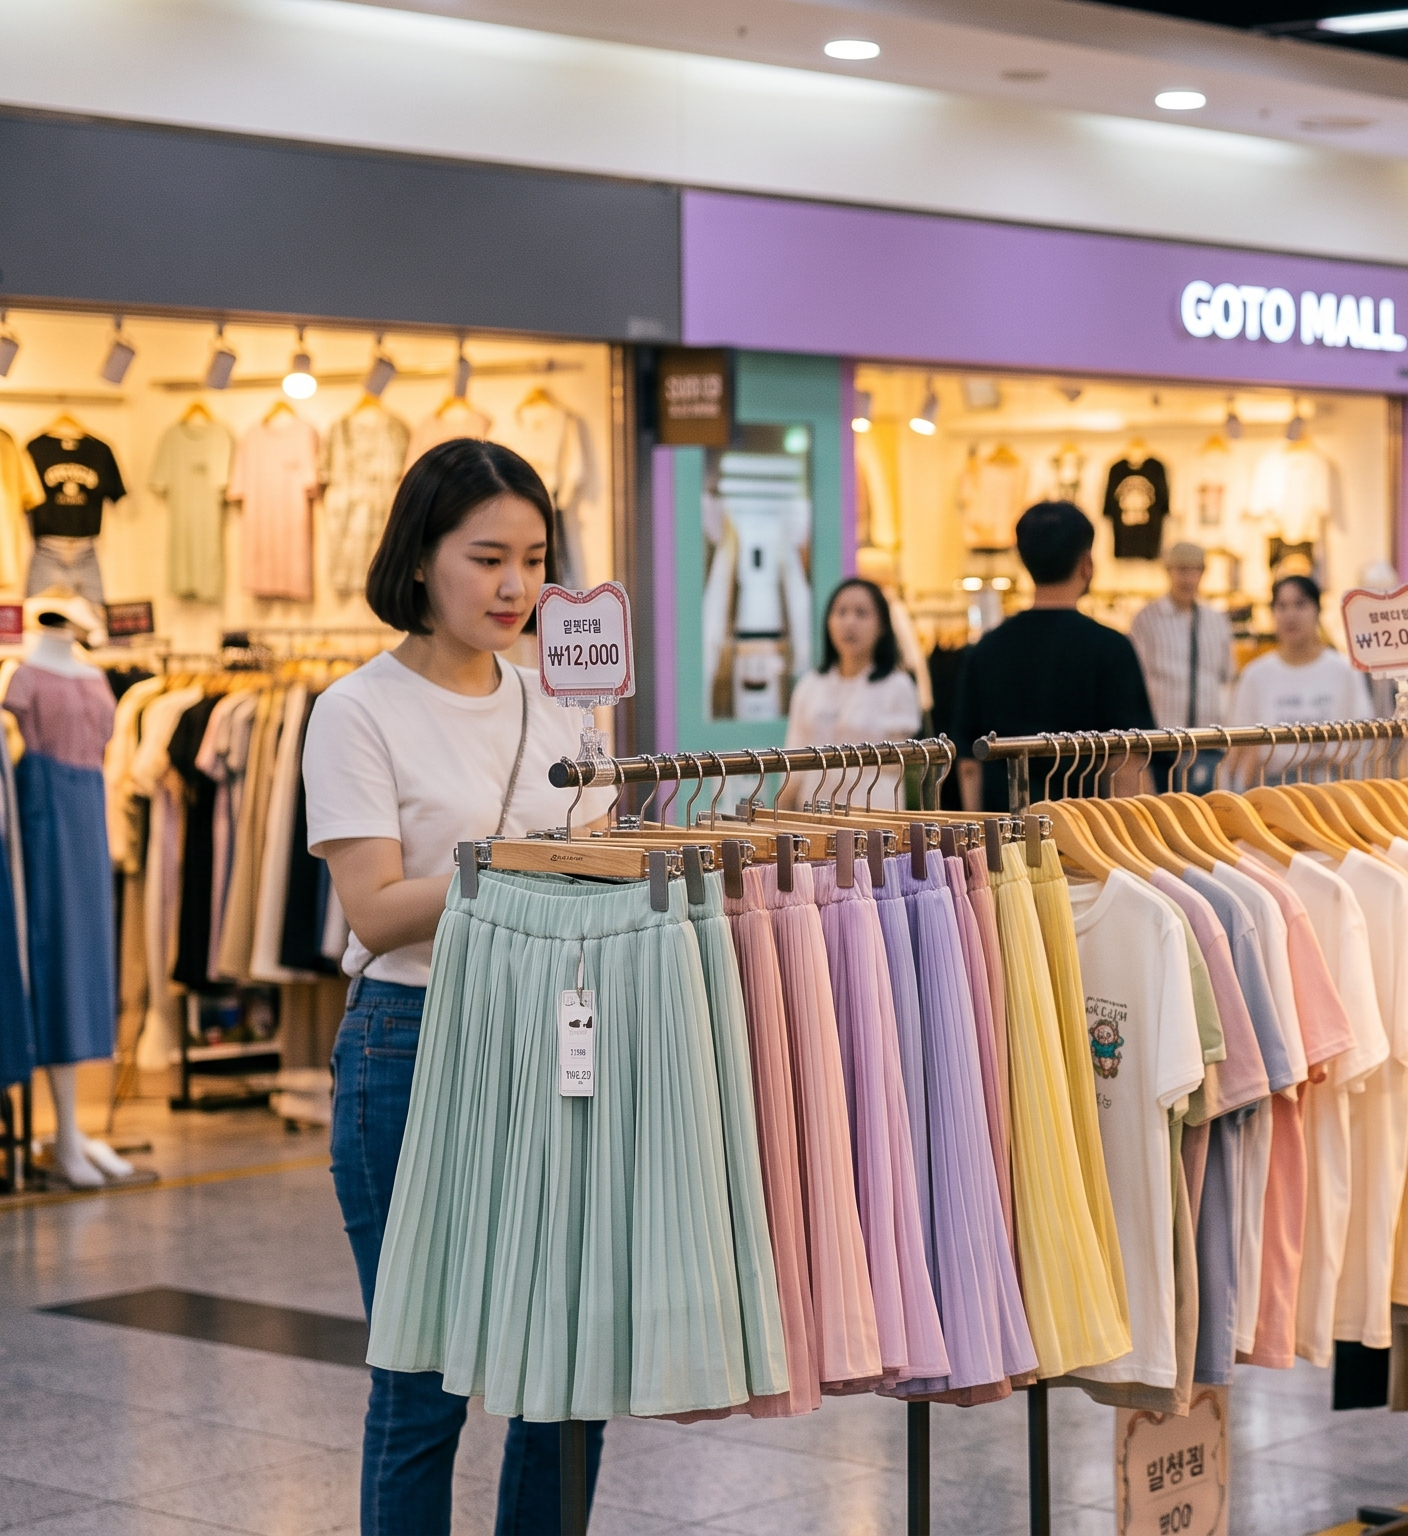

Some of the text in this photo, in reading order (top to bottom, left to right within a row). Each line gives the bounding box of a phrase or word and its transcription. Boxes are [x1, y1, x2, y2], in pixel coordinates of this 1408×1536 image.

[1180, 279, 1408, 352] GOTO MALL
[547, 643, 619, 670] ₩12,000
